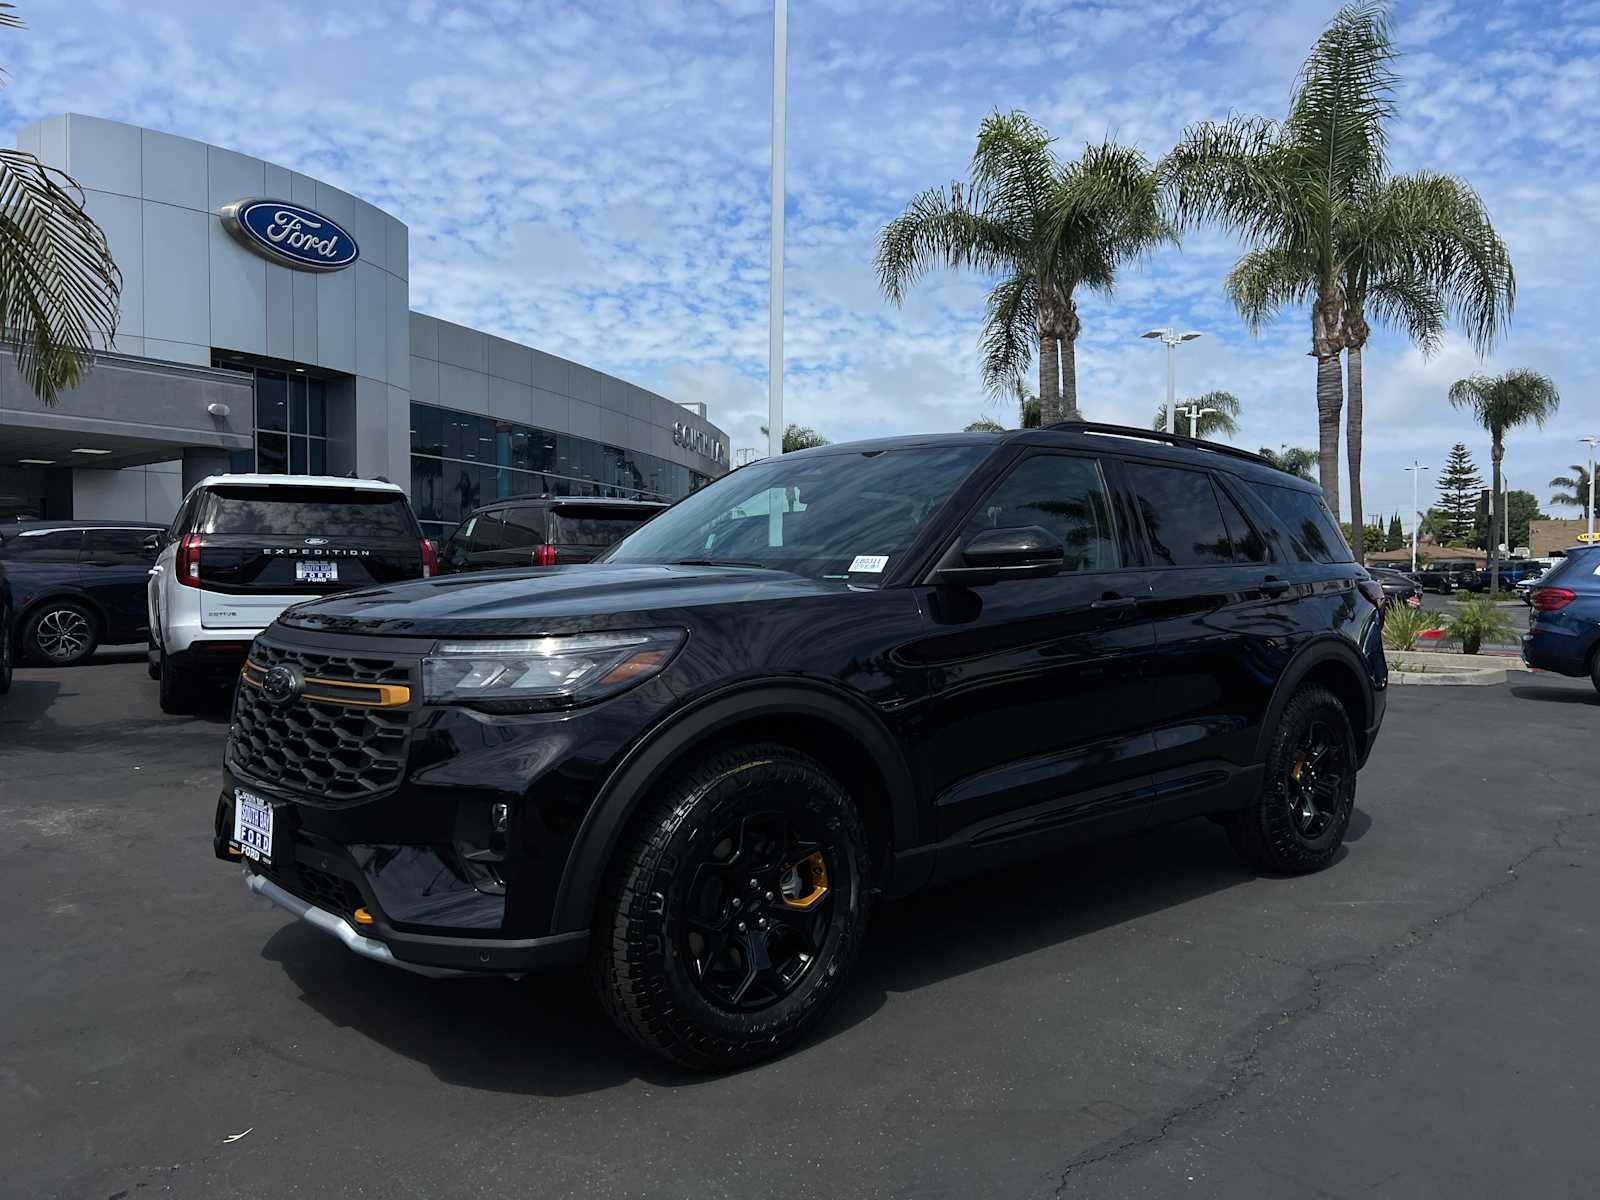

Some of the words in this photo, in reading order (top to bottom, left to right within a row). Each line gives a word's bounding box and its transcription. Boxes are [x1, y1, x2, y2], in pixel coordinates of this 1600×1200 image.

[266, 210, 339, 258] Ford
[263, 548, 370, 556] EXPEDITION
[241, 804, 260, 826] SOUTH
[241, 827, 269, 850] FORD
[241, 845, 260, 861] FORD
